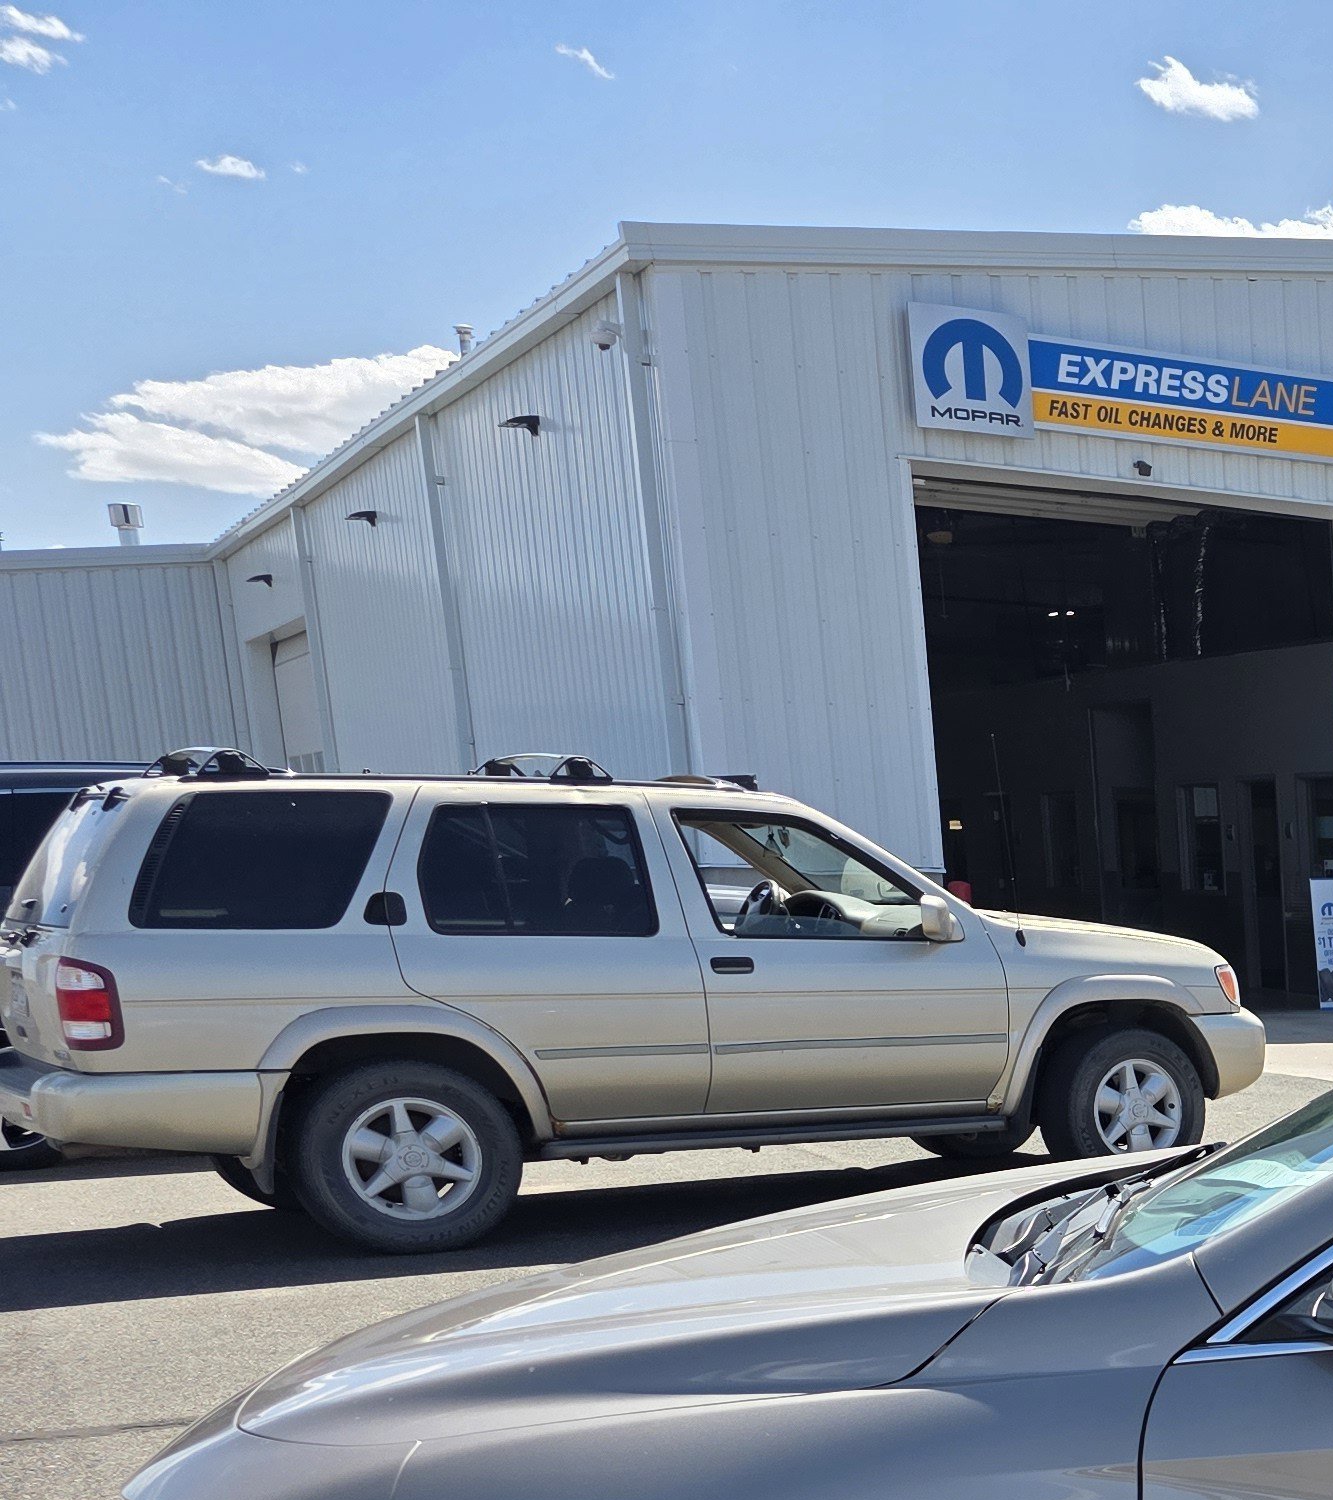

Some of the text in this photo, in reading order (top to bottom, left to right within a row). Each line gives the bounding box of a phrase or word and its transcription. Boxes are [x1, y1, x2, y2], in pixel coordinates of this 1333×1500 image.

[931, 404, 1021, 428] MOPAR
[1048, 399, 1279, 444] FAST OIL CHANGES & MORE
[1317, 936, 1326, 948] $1
